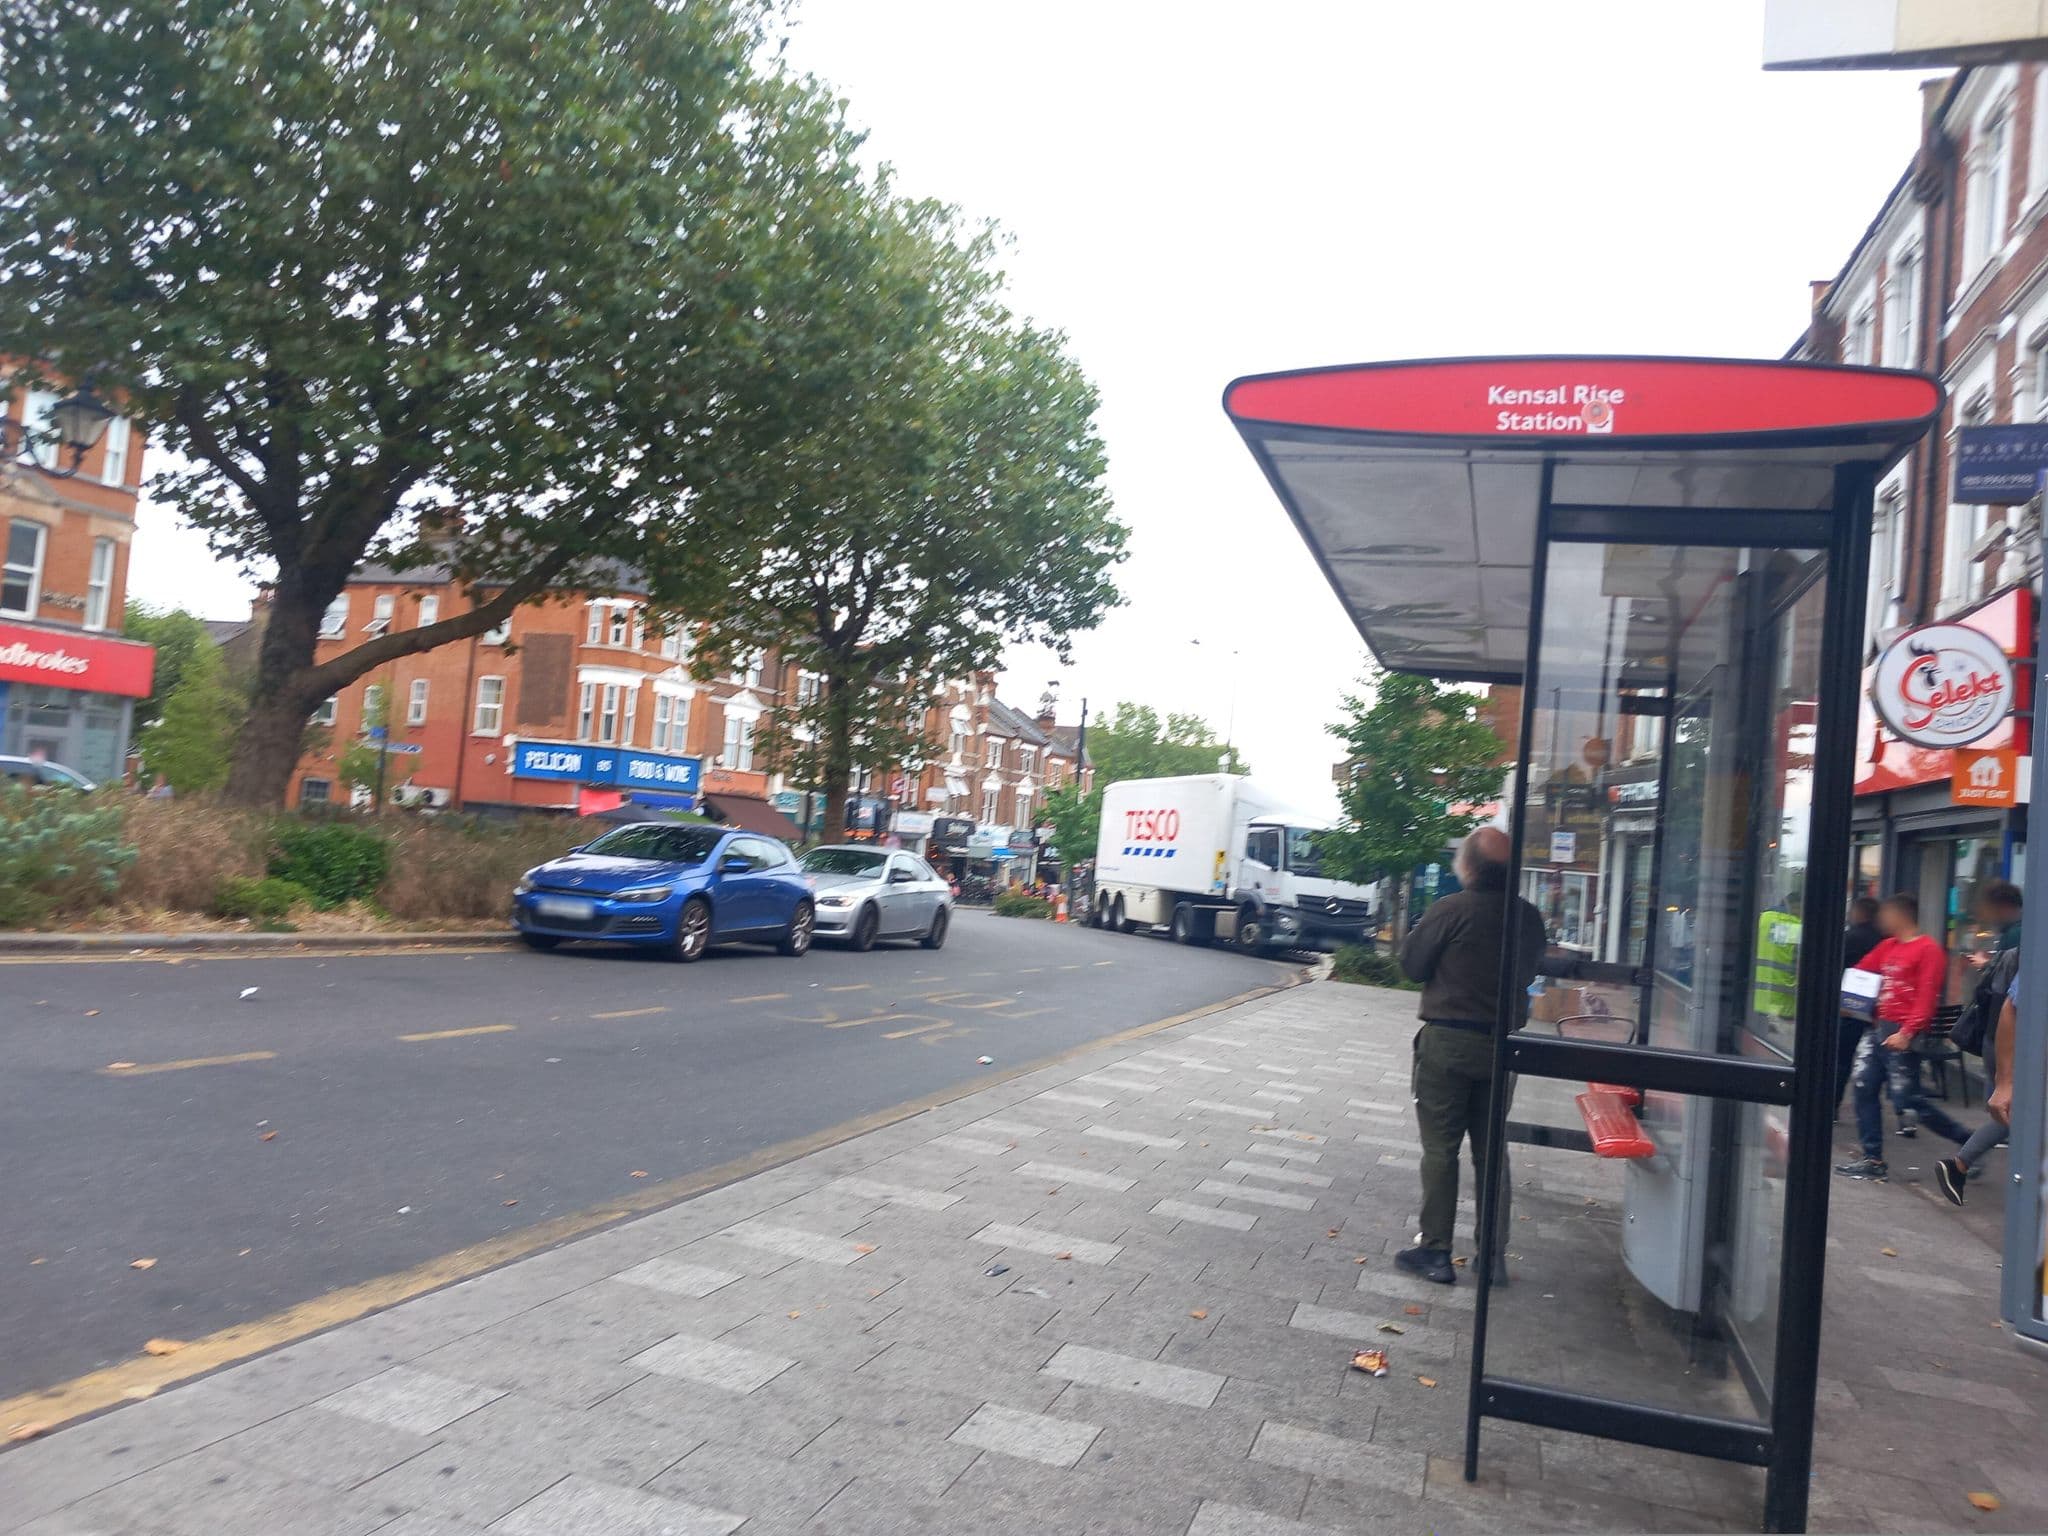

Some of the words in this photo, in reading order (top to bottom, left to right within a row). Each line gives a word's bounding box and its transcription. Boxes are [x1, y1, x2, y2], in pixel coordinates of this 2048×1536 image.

[1488, 385, 1567, 405] Kensal
[1574, 384, 1625, 405] Rise
[1496, 411, 1582, 431] Station
[1899, 653, 2004, 730] Selekt
[524, 750, 583, 773] PELICAN
[1125, 808, 1180, 842] TESCO
